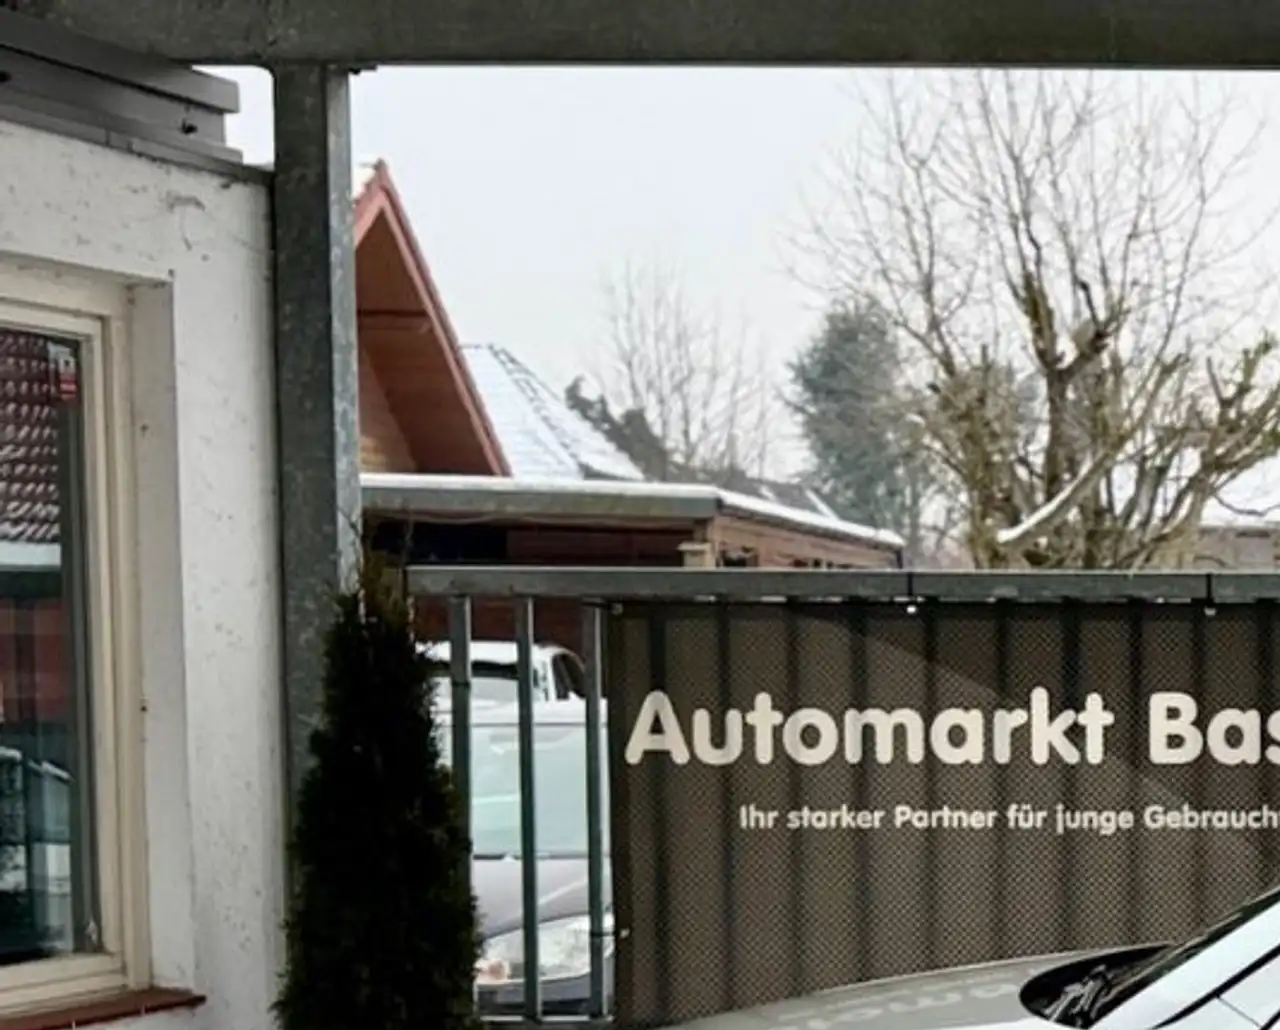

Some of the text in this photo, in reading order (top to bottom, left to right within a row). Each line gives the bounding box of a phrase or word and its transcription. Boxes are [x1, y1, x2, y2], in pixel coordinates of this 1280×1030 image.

[625, 687, 1115, 765] Automarkt
[740, 804, 778, 829] Ihr
[787, 803, 885, 830] starker
[894, 804, 997, 830] Partner
[1006, 803, 1048, 830] für
[1055, 803, 1134, 836] junge
